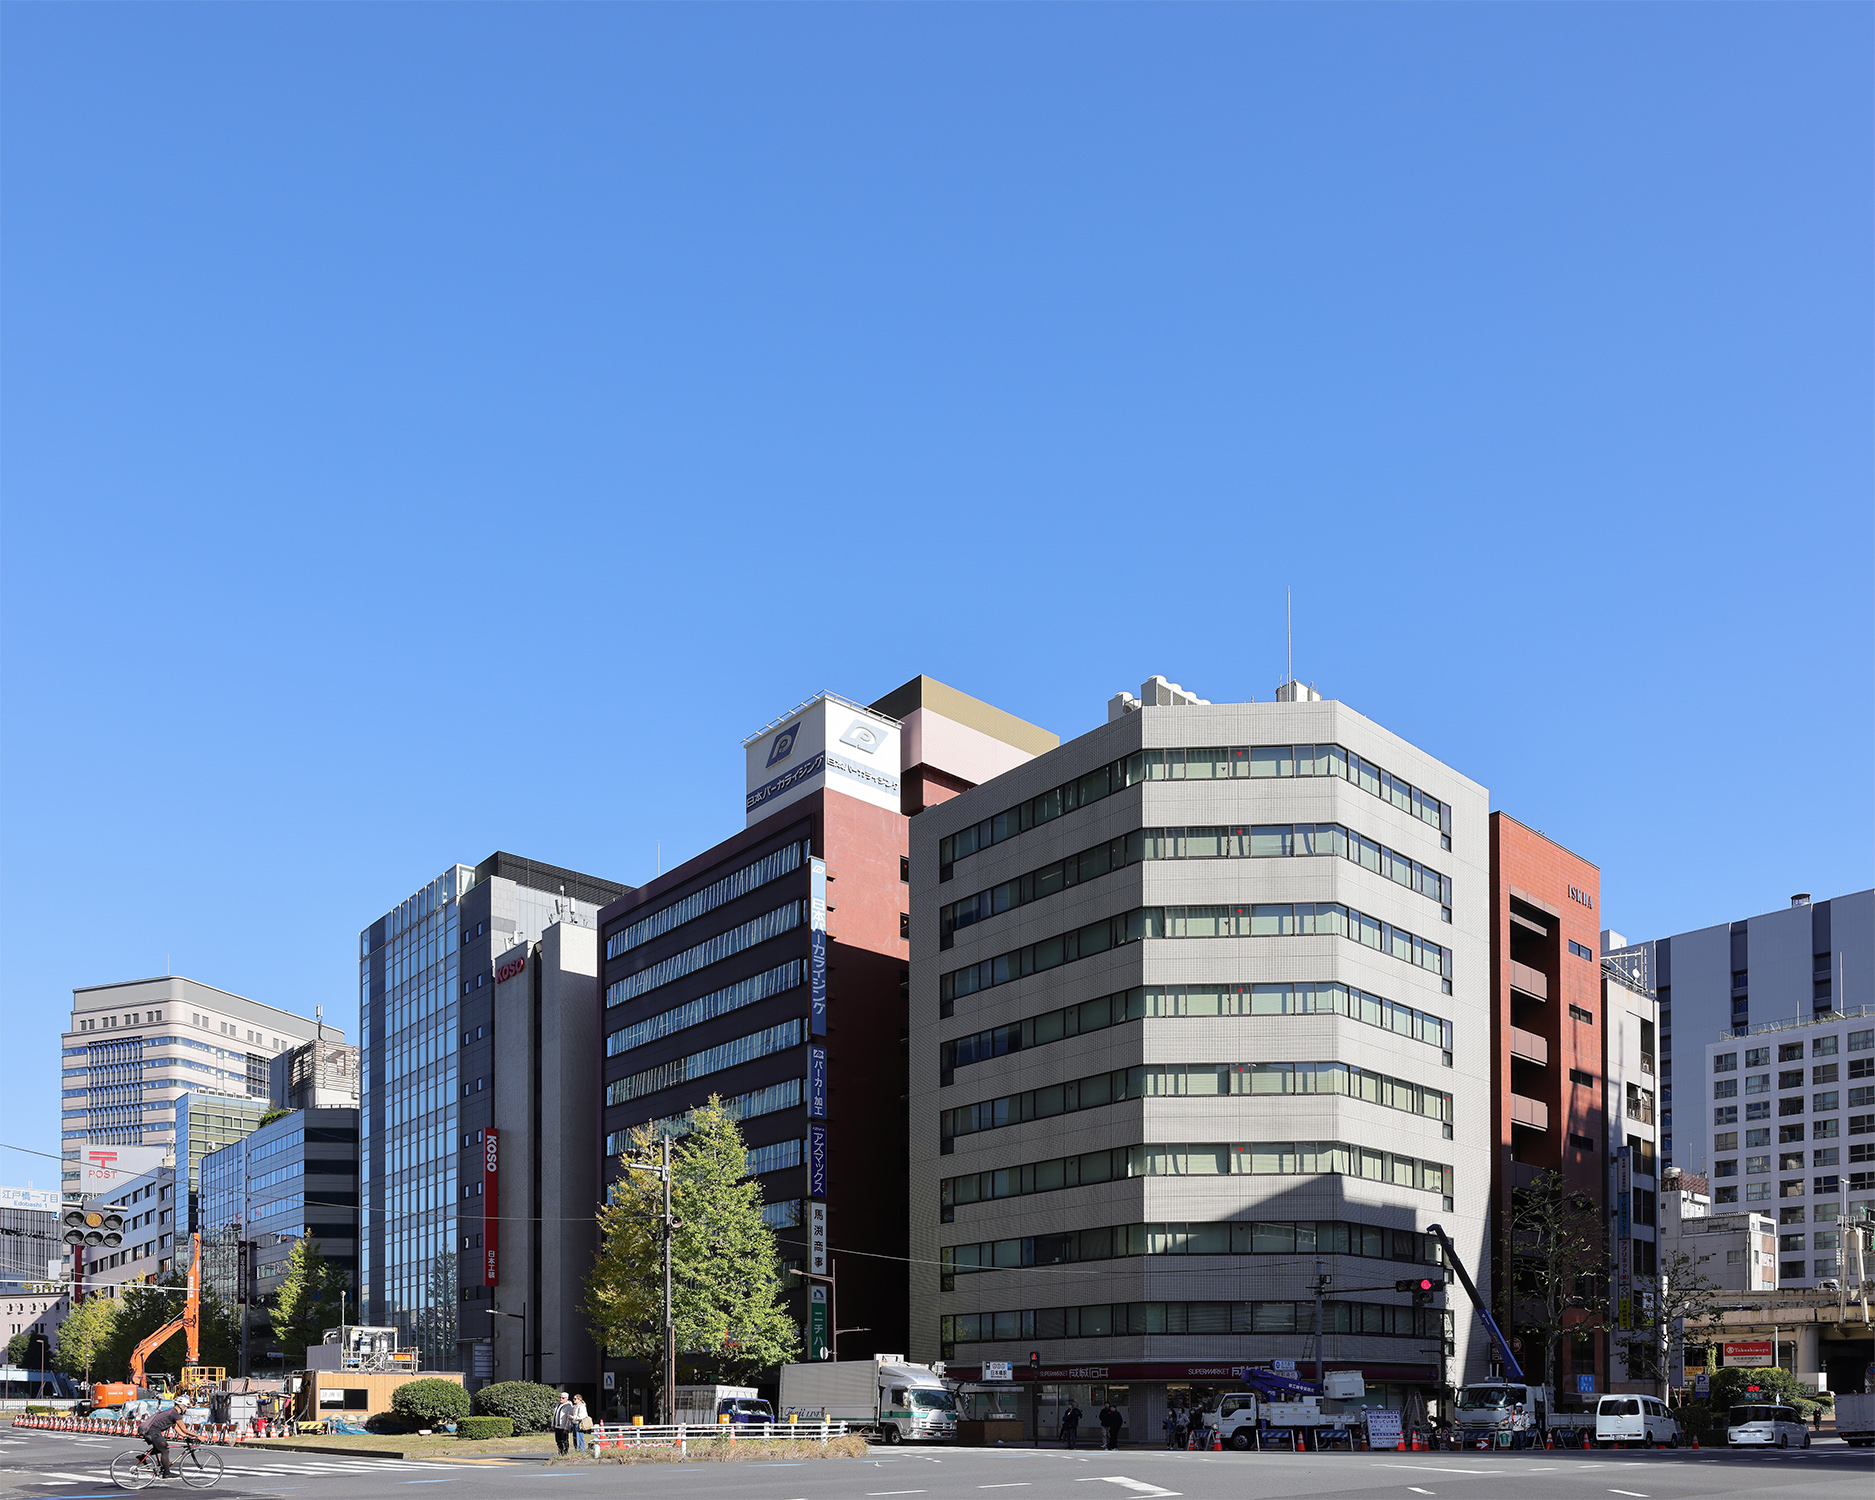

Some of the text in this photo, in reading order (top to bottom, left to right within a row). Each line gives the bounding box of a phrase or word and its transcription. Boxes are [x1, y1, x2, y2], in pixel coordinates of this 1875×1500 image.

[746, 755, 824, 808] 日本パーカライジング
[826, 757, 898, 791] 日本パーカライジング
[1568, 884, 1594, 909] ISKRA
[496, 957, 525, 984] KOSO
[811, 897, 826, 1015] 日本パーカライジング
[814, 1060, 824, 1116] パーカー加工
[486, 1134, 497, 1172] KOSO
[813, 1132, 824, 1193] アズマックス
[88, 1169, 117, 1179] POST
[1, 1189, 59, 1203] 江戸橋一丁目
[487, 1250, 496, 1279] 日本工装
[813, 1312, 824, 1346] ニチハ
[1188, 1368, 1230, 1376] SUPERMARKET
[1697, 1375, 1706, 1385] P
